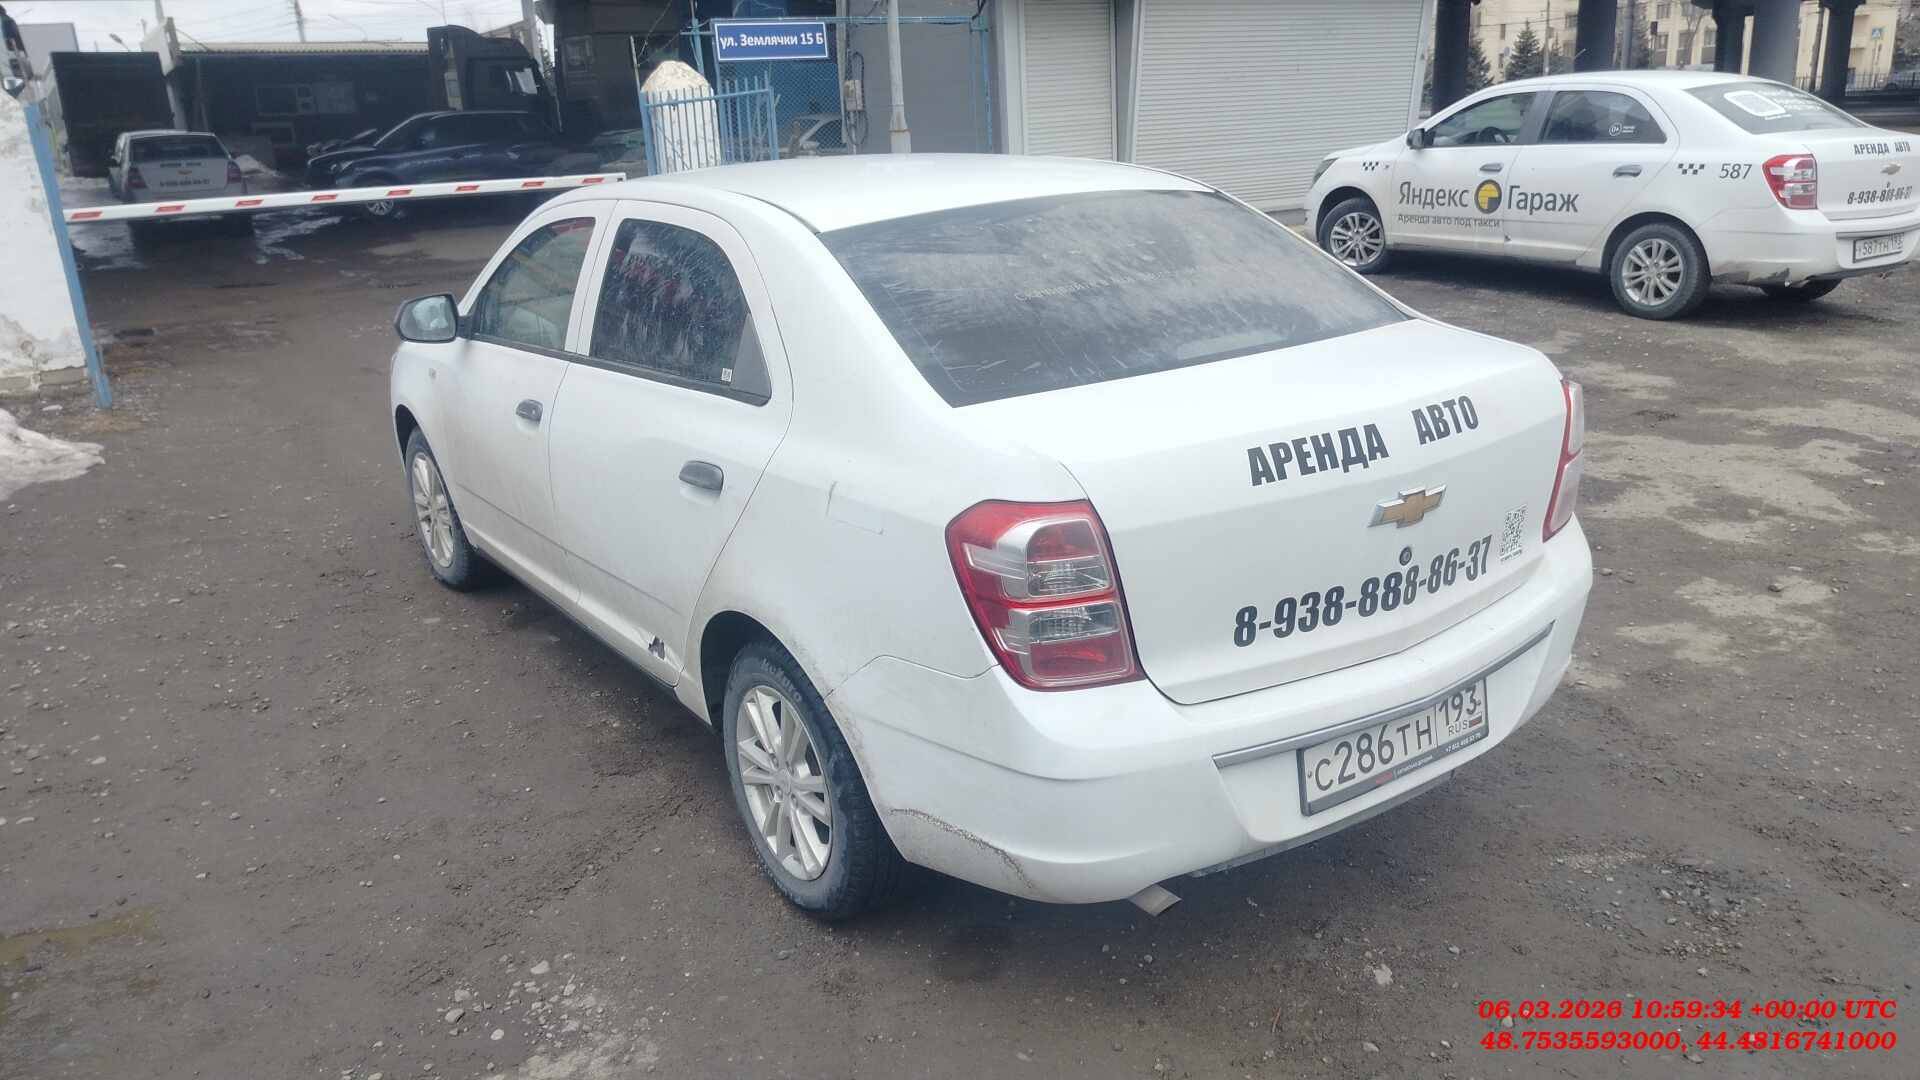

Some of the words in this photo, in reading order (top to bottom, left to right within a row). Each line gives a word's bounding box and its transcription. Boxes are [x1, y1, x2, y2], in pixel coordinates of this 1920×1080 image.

[720, 36, 738, 50] ул.
[740, 33, 798, 47] Землячки
[800, 33, 814, 45] 15
[815, 33, 824, 45] Б
[1854, 143, 1890, 155] АРЕНДА
[1895, 141, 1911, 152] АВТО
[1719, 163, 1752, 179] 587
[1399, 181, 1470, 210] Яндекс
[1507, 185, 1579, 215] Гараж
[1398, 214, 1430, 224] Аренда
[1431, 216, 1452, 225] авто
[1454, 216, 1472, 228] под
[1473, 218, 1500, 227] такси
[1247, 423, 1390, 487] АРЕНДА
[1411, 395, 1479, 445] АВТО
[1233, 534, 1493, 648] 8-938-888-86-37
[1438, 685, 1478, 726] 193
[1448, 720, 1469, 737] RUS
